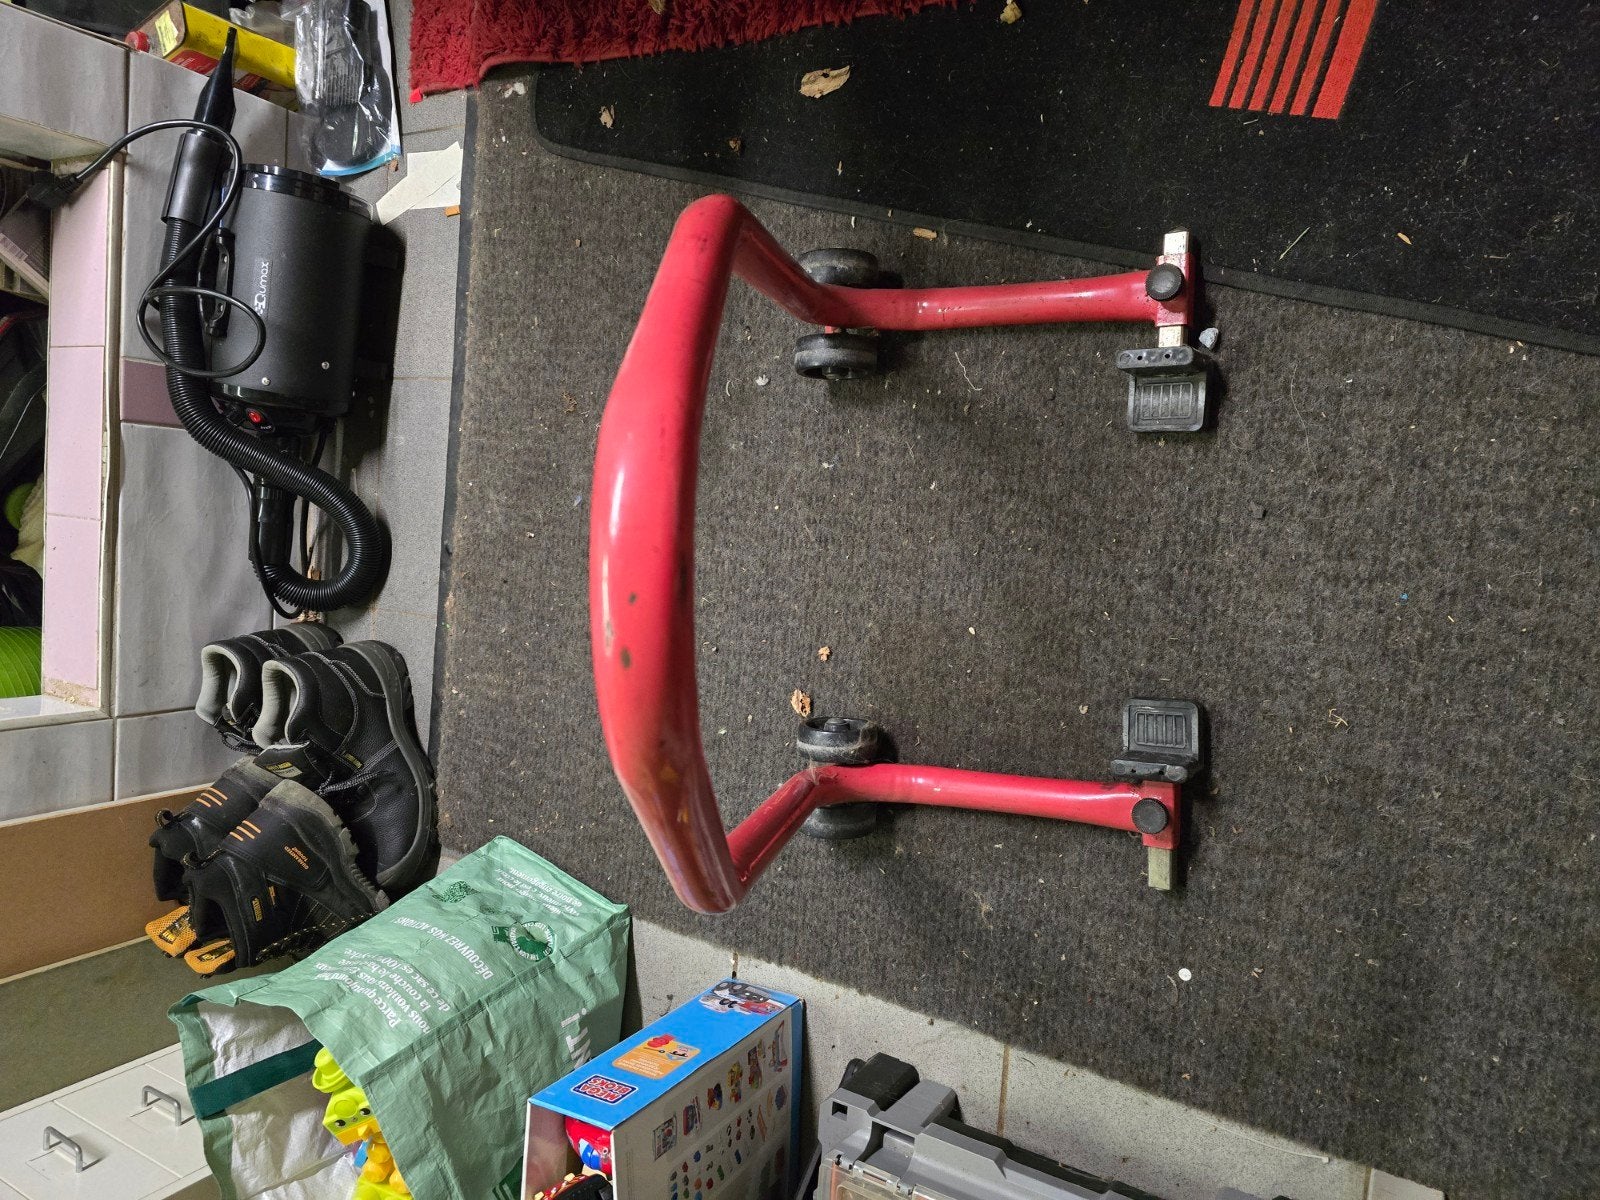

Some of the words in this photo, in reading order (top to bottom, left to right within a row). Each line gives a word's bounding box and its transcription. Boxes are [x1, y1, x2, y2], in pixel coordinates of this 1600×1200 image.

[254, 261, 269, 306] Qumax
[427, 927, 449, 939] NOS
[446, 936, 493, 979] DÉCOUVREZ
[400, 964, 413, 973] es
[390, 973, 421, 1000] couche
[412, 974, 429, 987] sac
[426, 988, 438, 998] ce
[374, 997, 402, 1028] Parce
[420, 1000, 431, 1012] la
[437, 999, 450, 1011] de
[408, 1010, 429, 1033] nous
[578, 1083, 621, 1101] MEGA
[588, 1076, 631, 1095] BLOKS
